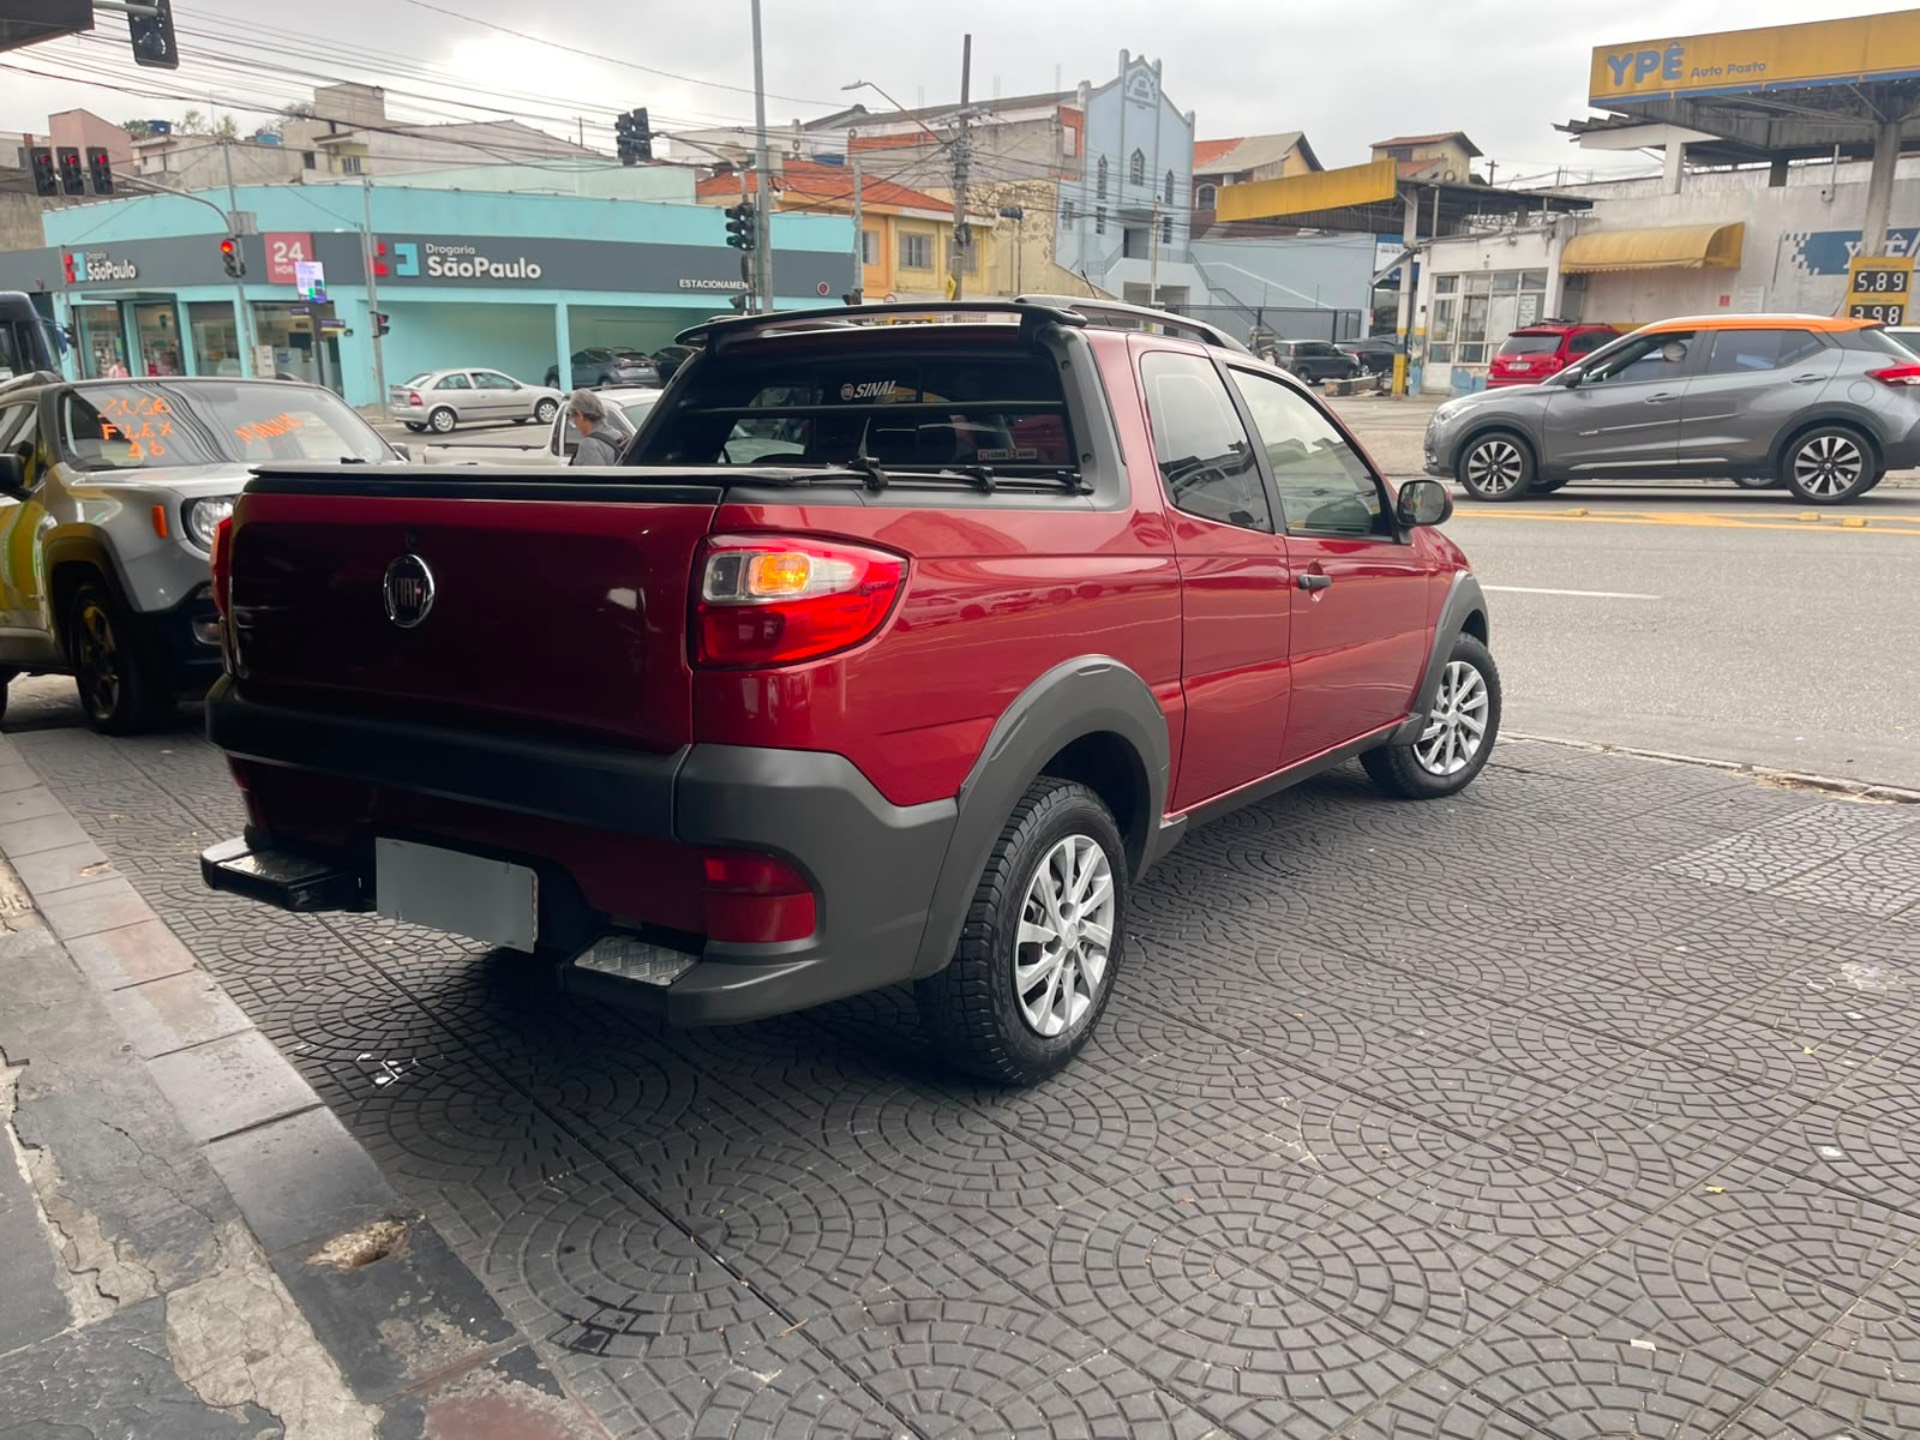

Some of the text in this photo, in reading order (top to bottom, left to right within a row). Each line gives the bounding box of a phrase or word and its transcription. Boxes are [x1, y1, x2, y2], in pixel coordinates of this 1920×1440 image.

[1607, 41, 1685, 86] YPÊ
[1690, 67, 1723, 78] Auto
[273, 241, 304, 263] 24
[425, 243, 475, 255] Drogaria
[87, 259, 136, 281] SãoPaulo
[275, 264, 295, 275] HOR
[427, 256, 541, 278] SãoPaulo
[679, 279, 750, 290] ESTACIONAMEN
[1857, 272, 1904, 292] 5,89
[1855, 305, 1900, 325] 398
[854, 380, 897, 398] SINAL
[101, 420, 174, 441] FLEX
